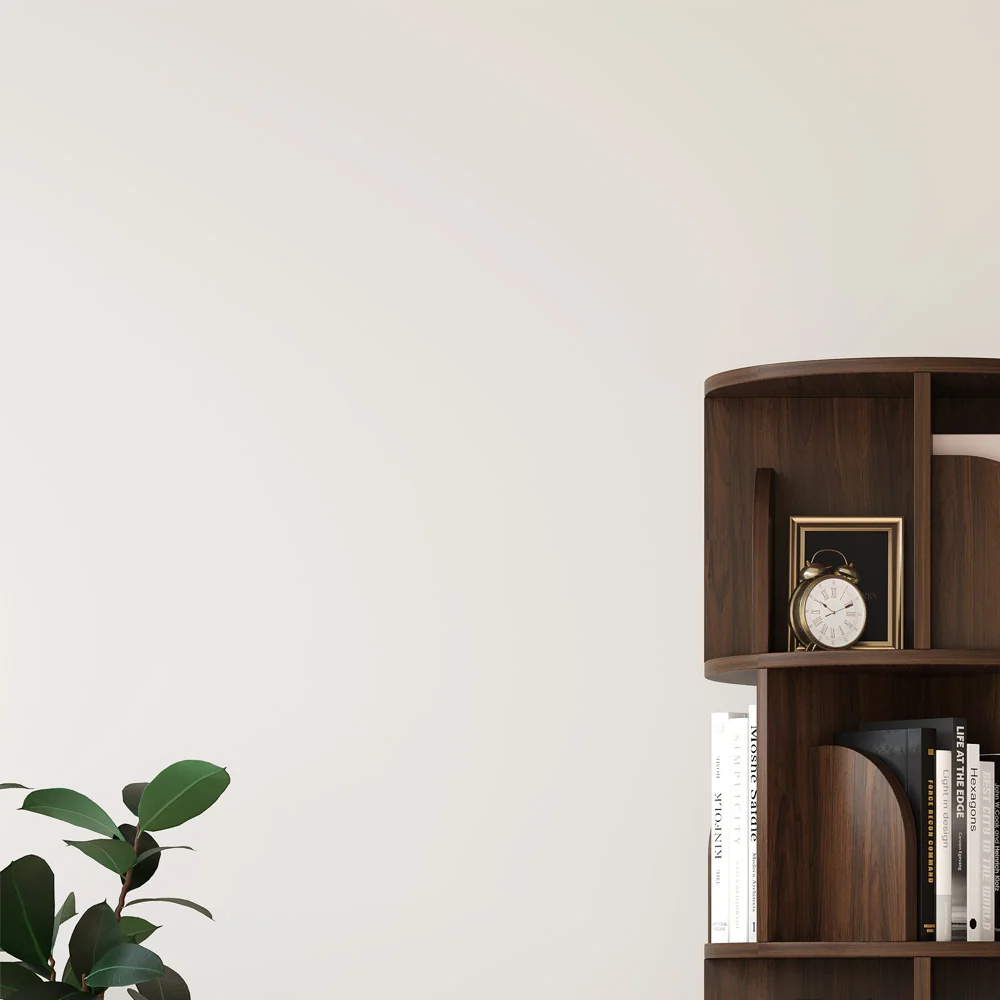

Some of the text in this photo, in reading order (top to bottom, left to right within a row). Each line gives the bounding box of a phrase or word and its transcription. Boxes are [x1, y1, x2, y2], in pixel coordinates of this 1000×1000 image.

[956, 726, 964, 819] LIFE AT THE EDGE
[982, 771, 991, 804] BEST
[943, 799, 949, 809] in
[969, 767, 978, 832] Hexagons
[714, 792, 722, 859] KINFOLK
[941, 812, 949, 848] design
[982, 806, 991, 836] CITY
[982, 857, 991, 883] THE
[982, 886, 991, 931] WORLD
